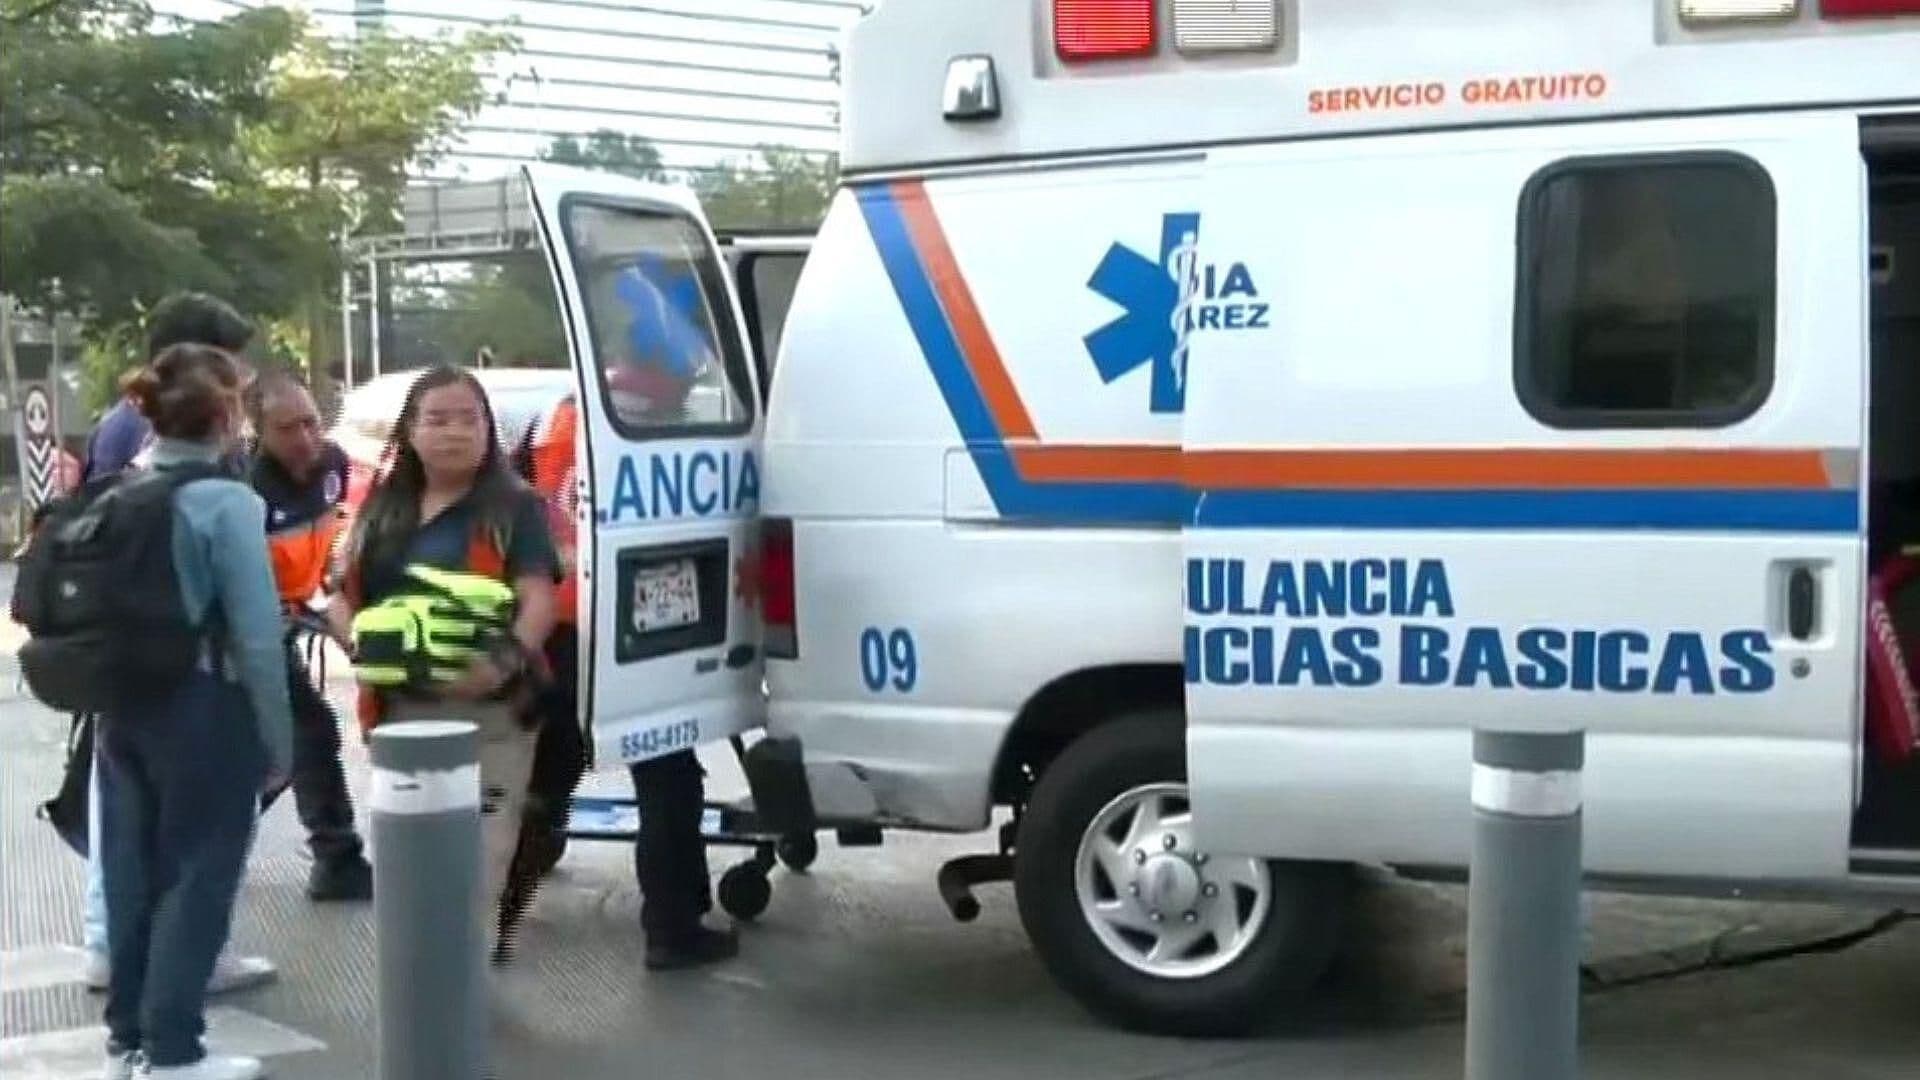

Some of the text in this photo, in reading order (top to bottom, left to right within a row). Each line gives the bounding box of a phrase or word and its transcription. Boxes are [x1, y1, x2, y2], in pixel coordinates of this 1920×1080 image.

[1308, 73, 1606, 113] SERVICIO GRATUITO
[597, 448, 761, 524] ANCIA
[1186, 558, 1455, 618] ULANCIA
[860, 626, 917, 693] 09
[1399, 624, 1776, 694] BASICAS
